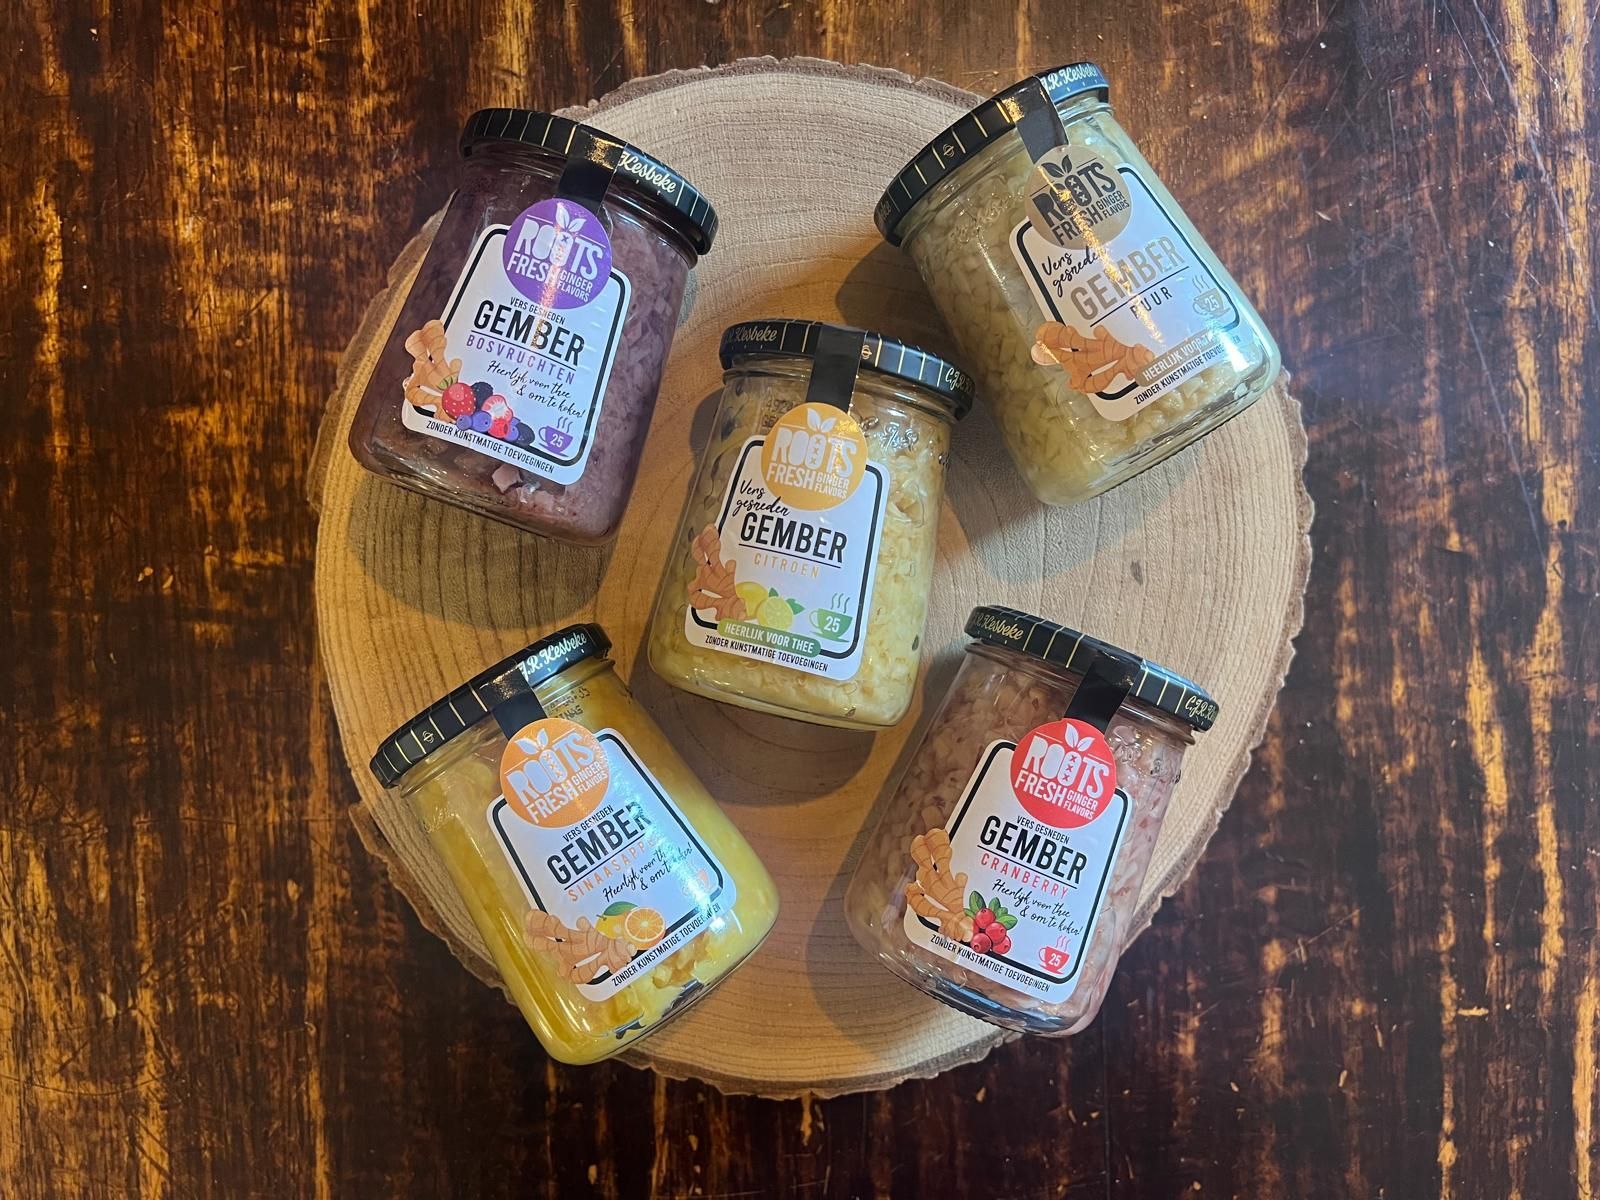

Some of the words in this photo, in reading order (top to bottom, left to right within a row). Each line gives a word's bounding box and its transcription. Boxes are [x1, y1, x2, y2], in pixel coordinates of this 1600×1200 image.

[618, 150, 677, 193] Kesbeke
[1032, 162, 1116, 228] ROOTS
[1096, 190, 1125, 210] GINGER
[1102, 200, 1130, 219] FLAVORS
[514, 218, 604, 280] ROOTS
[1042, 252, 1073, 276] Vers
[559, 269, 603, 293] GINGER
[1053, 246, 1098, 298] gesnede
[1070, 236, 1185, 321] GEMBER
[510, 296, 528, 310] VERS
[557, 280, 590, 303] FLAVORS
[1205, 294, 1219, 312] 25
[473, 299, 585, 367] GEMBER
[466, 334, 575, 385] BOSVRUCHTEN
[1142, 350, 1183, 382] HEERLIJK
[486, 360, 528, 386] Heerlijk
[529, 377, 549, 389] voor
[550, 381, 572, 399] thee
[1133, 384, 1161, 405] ZONDER
[1162, 355, 1204, 388] KUNSTMATIGE
[516, 385, 525, 397] &
[528, 392, 549, 404] om
[548, 395, 558, 408] te
[426, 420, 453, 437] ZONDER
[453, 428, 503, 456] KUNSTMATIGE
[504, 446, 555, 474] TOEVOEGINGEN
[550, 433, 563, 447] 25
[771, 427, 857, 477] ROOTS
[740, 478, 765, 499] Vers
[766, 462, 816, 490] FRESH
[814, 483, 848, 499] FLAVORS
[816, 471, 850, 490] GINGER
[732, 496, 790, 517] gesneden
[740, 512, 848, 563] GEMBER
[754, 553, 820, 578] CITROEN
[724, 623, 765, 642] HEERLIJK
[766, 632, 790, 648] VOOR
[792, 638, 815, 654] THEE
[823, 615, 841, 633] 25
[983, 614, 1024, 640] Kesbeke
[539, 632, 587, 665] Kesbeke
[705, 635, 729, 649] ZONDER
[729, 640, 777, 659] KUNSTMATIGE
[777, 651, 829, 672] TOEVOEGINGEN
[506, 732, 594, 806] ROOTS
[571, 761, 603, 786] GINGER
[577, 770, 608, 794] FLAVORS
[1022, 735, 1109, 798] ROOTS
[526, 780, 580, 824] FRESH
[1014, 769, 1067, 807] FRESH
[1066, 789, 1098, 811] GINGER
[562, 827, 582, 842] VERS
[581, 804, 614, 831] GESNEDEN
[1063, 801, 1095, 820] FLAVORS
[547, 801, 652, 885] GEMBER
[1016, 815, 1035, 830] VERS
[1035, 823, 1070, 845] GESNEDEN
[980, 815, 1087, 884] GEMBER
[602, 867, 640, 902] Heerlijk
[640, 858, 656, 874] voor
[640, 877, 648, 891] &
[650, 869, 665, 883] om
[981, 853, 1068, 899] CRANBERRY
[992, 878, 1032, 907] Heerlijk
[1032, 898, 1052, 909] voor
[1051, 902, 1071, 918] thee
[1020, 906, 1027, 918] &
[1030, 913, 1048, 924] om
[1047, 916, 1057, 928] te
[612, 965, 638, 986] ZONDER
[638, 934, 681, 970] KUNSTMATIGE
[930, 933, 957, 953] ZONDER
[956, 944, 1004, 975] KUNSTMATIGE
[1003, 967, 1051, 993] TOEVOEGINGEN
[1049, 952, 1062, 967] 25
